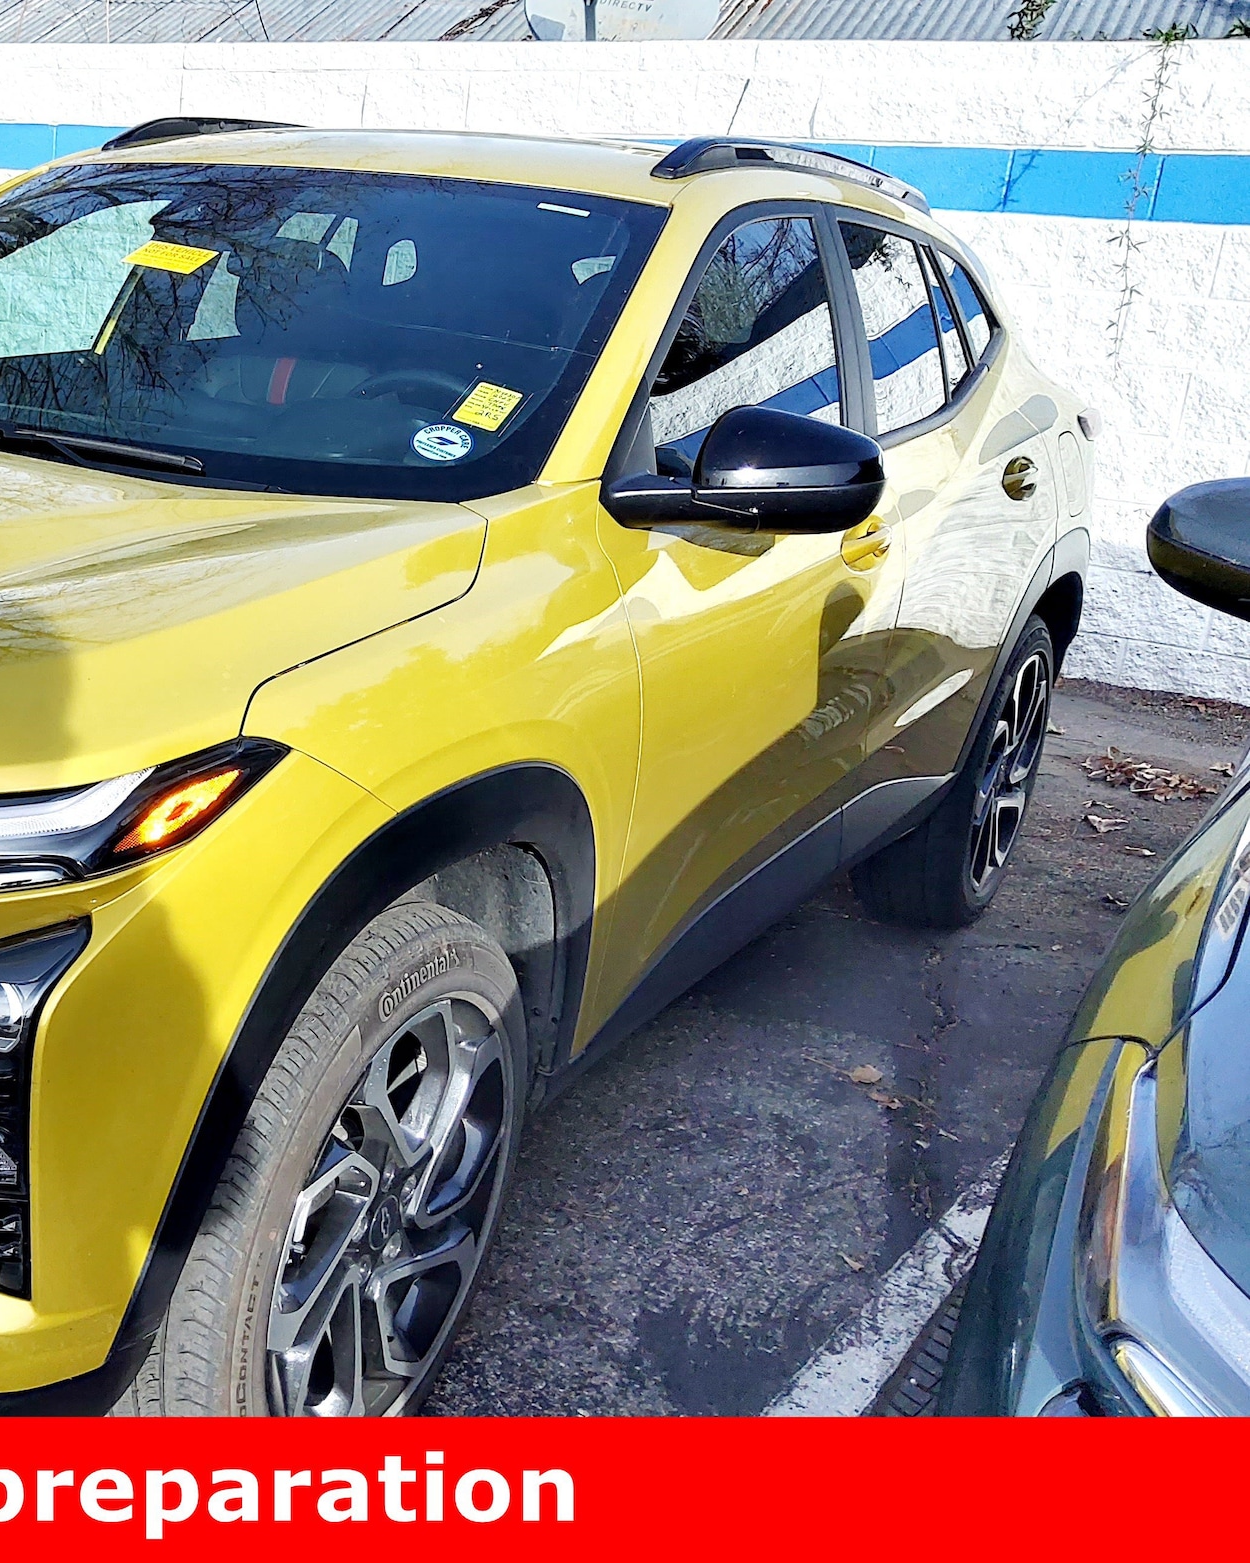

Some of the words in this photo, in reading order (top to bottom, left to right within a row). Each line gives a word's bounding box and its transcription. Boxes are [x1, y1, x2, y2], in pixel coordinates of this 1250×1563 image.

[599, 0, 652, 12] DIRECTV
[170, 245, 212, 258] VEHICLE
[179, 254, 201, 262] SALE
[423, 425, 462, 435] CROPPER
[378, 949, 451, 1023] Continental
